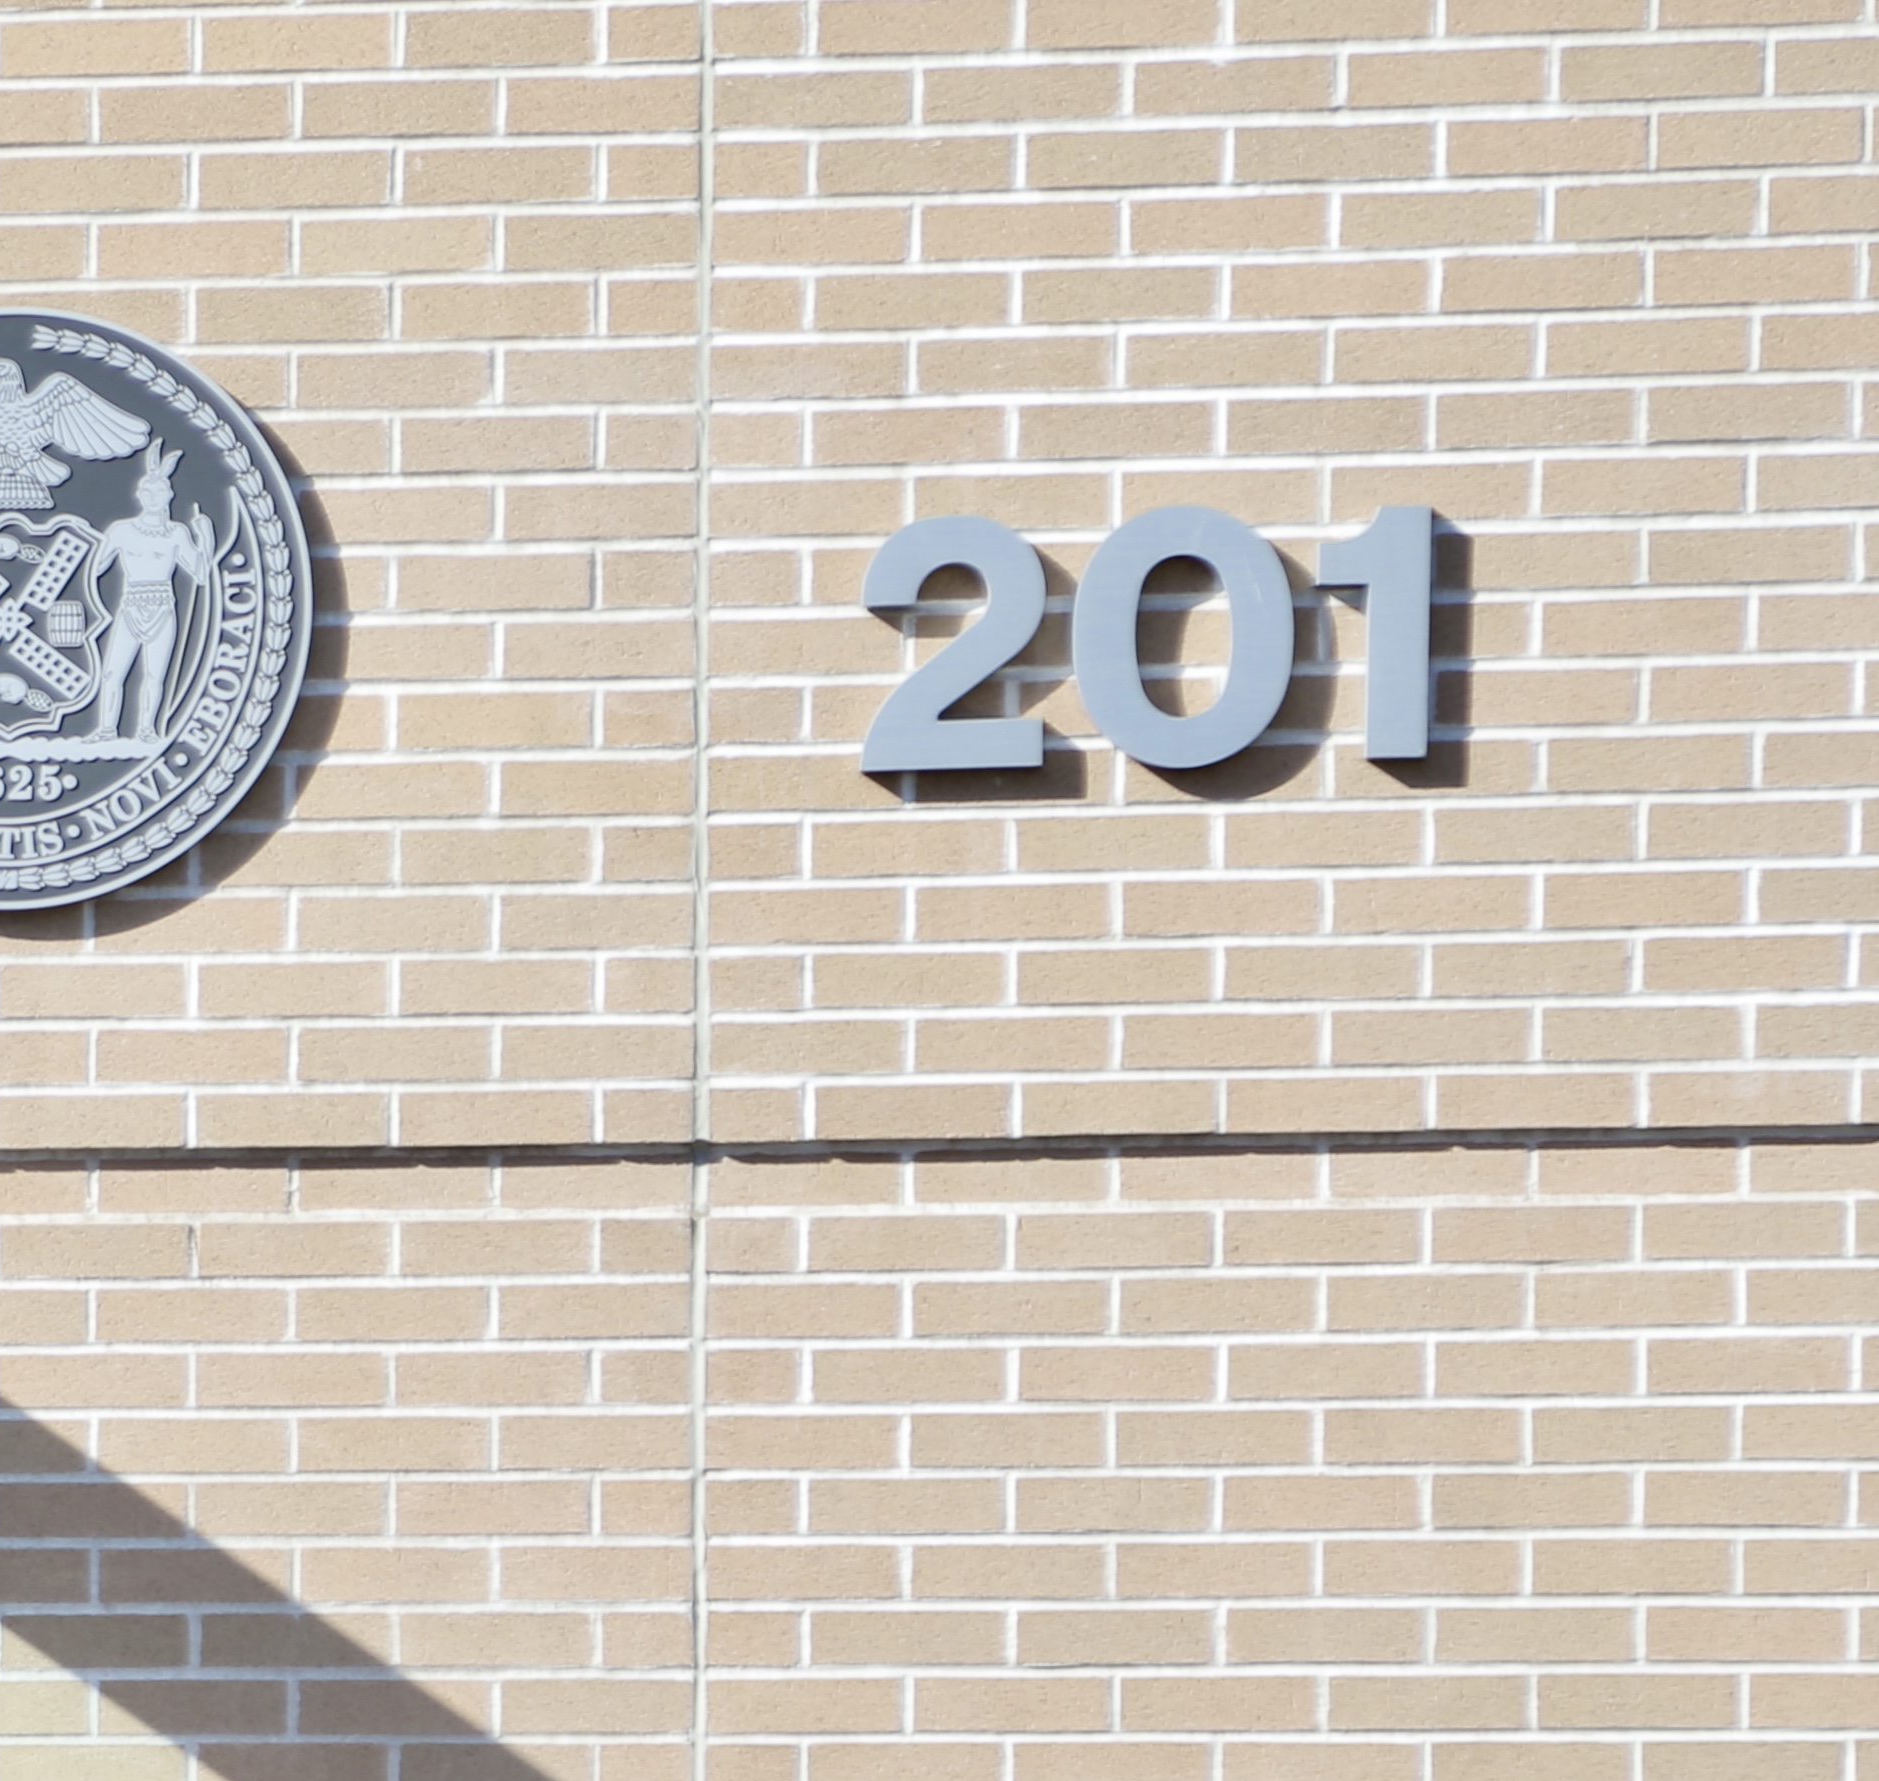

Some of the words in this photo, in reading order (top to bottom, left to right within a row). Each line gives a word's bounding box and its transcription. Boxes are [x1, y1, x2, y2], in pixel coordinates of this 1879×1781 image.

[79, 756, 183, 836] NOVI
[177, 568, 257, 757] EBORACI
[861, 505, 1433, 773] 201
